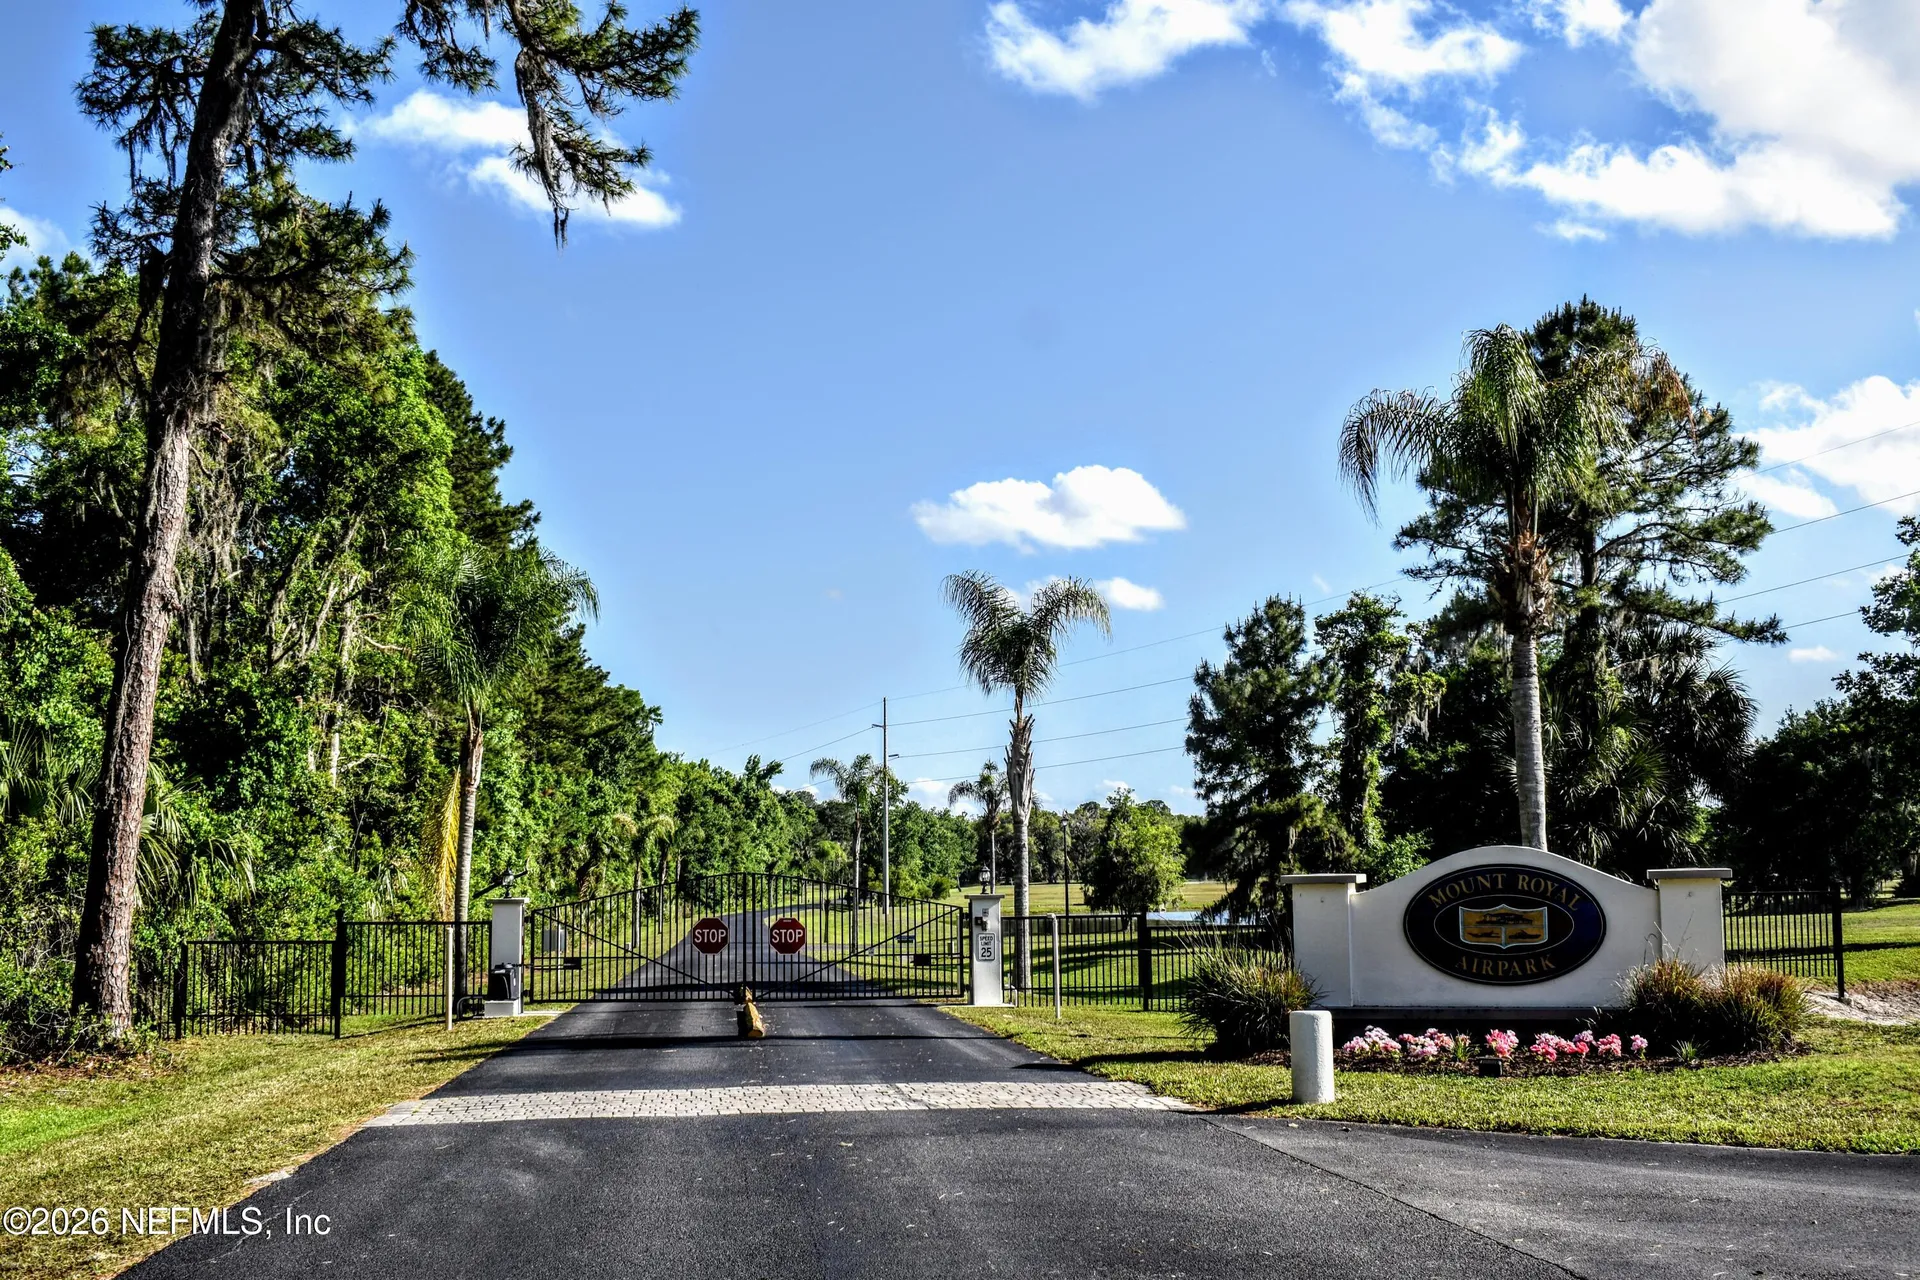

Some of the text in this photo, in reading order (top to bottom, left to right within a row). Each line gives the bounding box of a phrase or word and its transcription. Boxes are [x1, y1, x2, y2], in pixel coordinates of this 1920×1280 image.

[1427, 873, 1579, 911] MOUNT ROYAL
[694, 929, 727, 943] STOP
[771, 929, 804, 943] STOP
[981, 947, 992, 957] 25
[1455, 954, 1556, 976] AIRPARK
